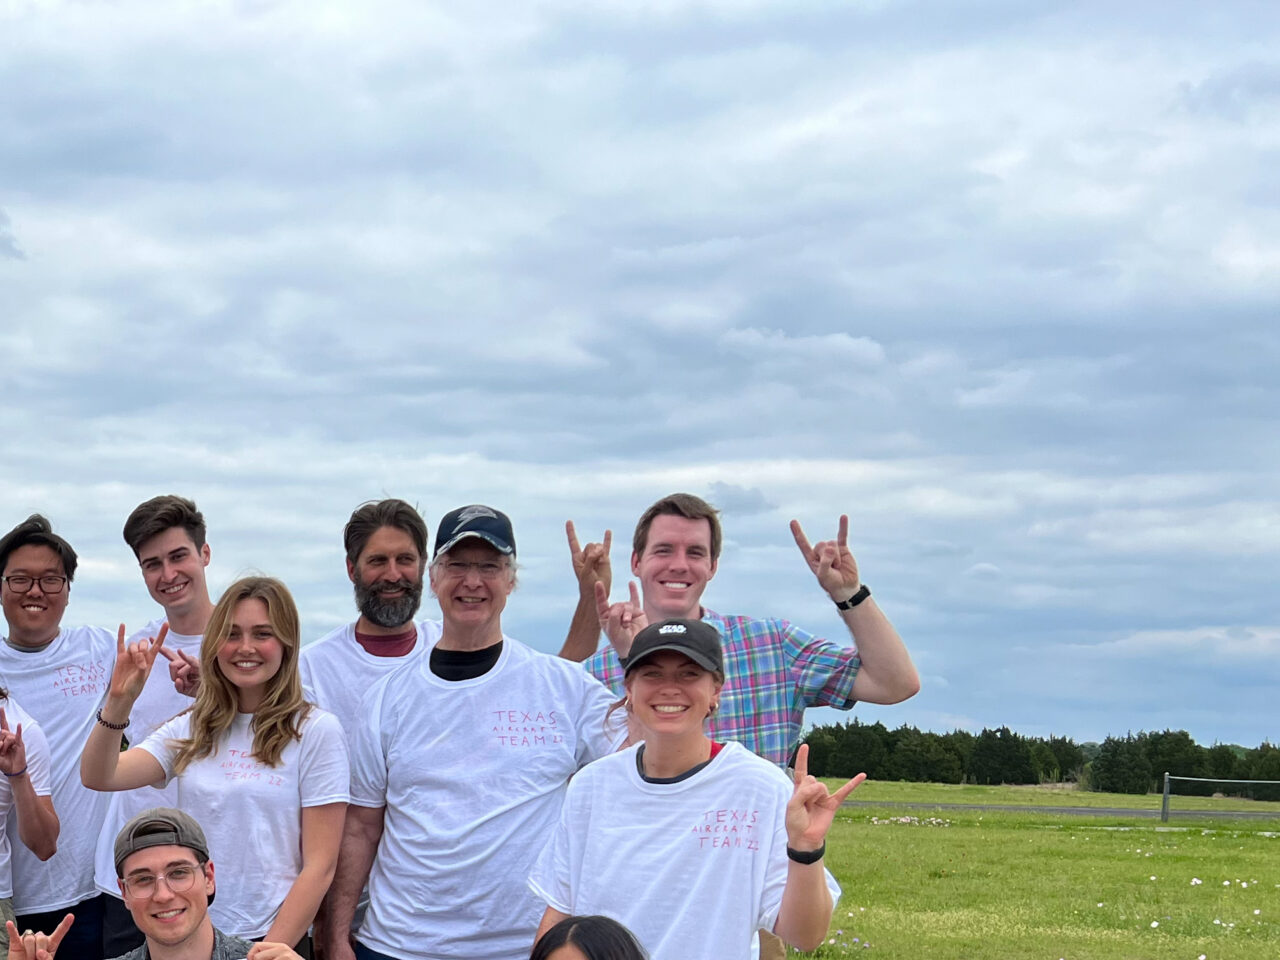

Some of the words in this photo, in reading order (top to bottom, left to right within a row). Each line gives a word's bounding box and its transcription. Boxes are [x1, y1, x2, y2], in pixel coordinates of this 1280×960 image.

[61, 683, 98, 697] TEAM
[492, 710, 558, 725] TEXAS
[497, 735, 546, 747] TEAM
[701, 809, 760, 823] TEXAS
